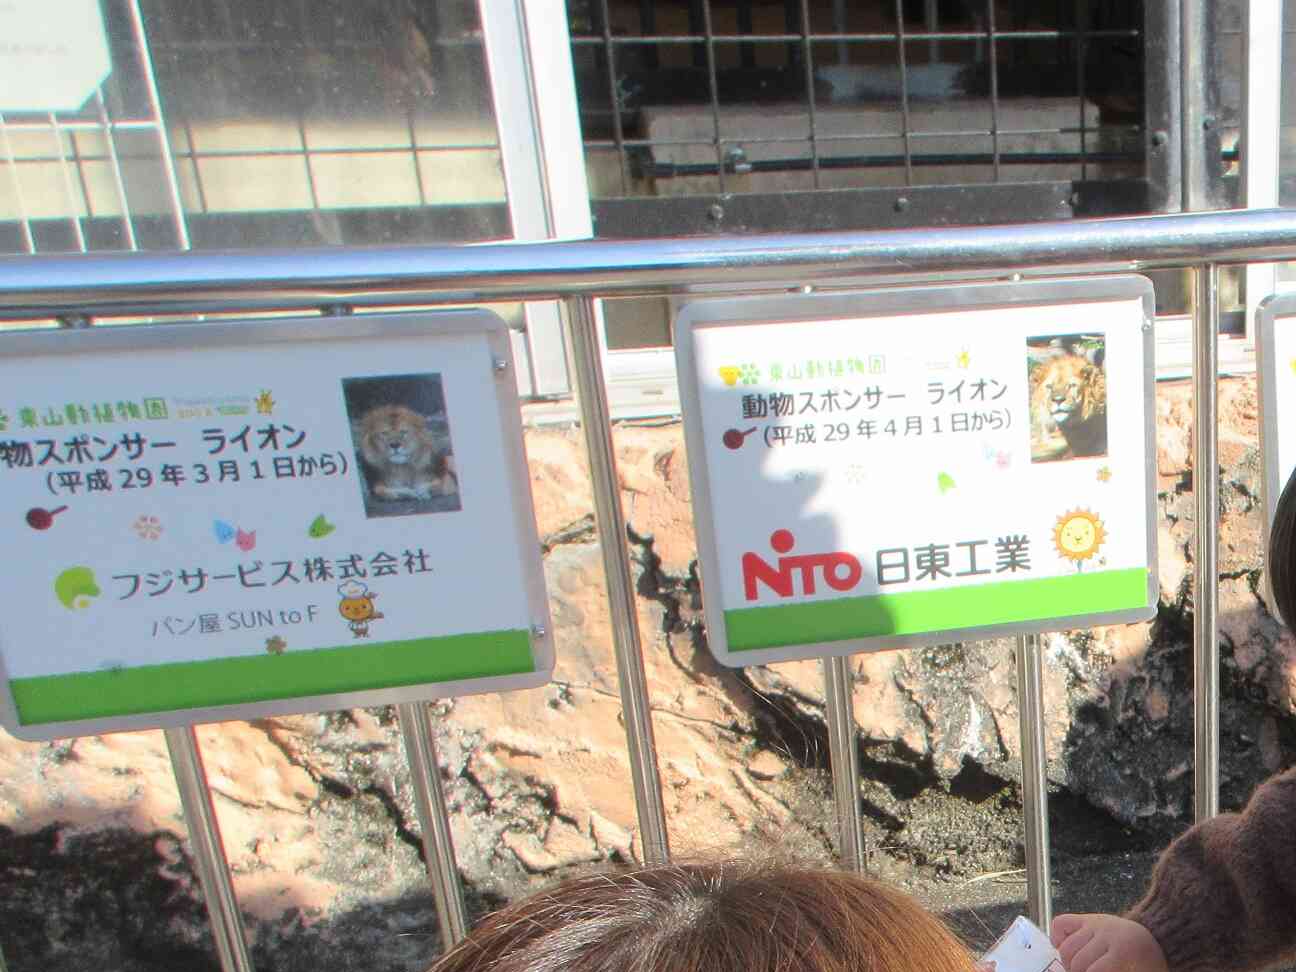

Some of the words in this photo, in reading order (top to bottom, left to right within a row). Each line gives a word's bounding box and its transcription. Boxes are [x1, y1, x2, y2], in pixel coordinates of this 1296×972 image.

[927, 378, 1008, 405] ライオン
[202, 423, 306, 454] ライオン
[111, 548, 433, 600] フジサービス株式会社
[875, 534, 1031, 586] 日東工業
[279, 609, 302, 624] to
[308, 604, 319, 622] F
